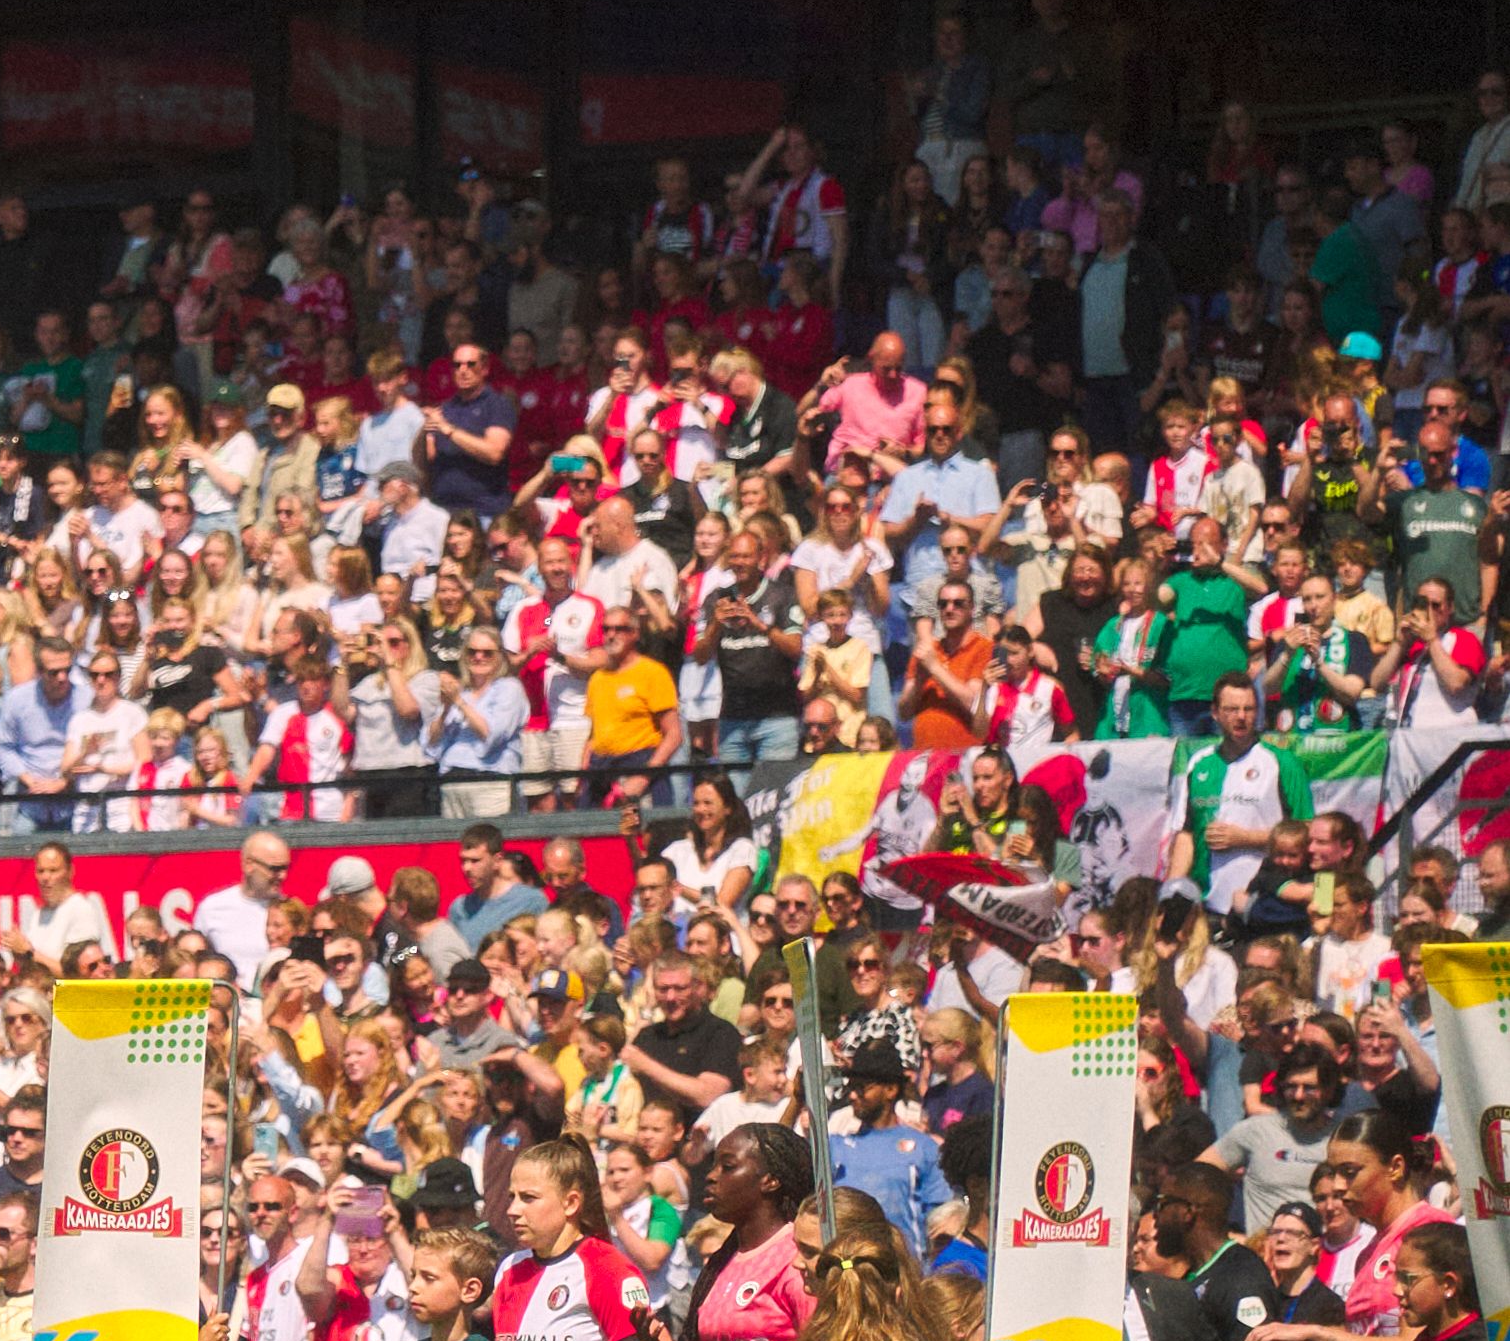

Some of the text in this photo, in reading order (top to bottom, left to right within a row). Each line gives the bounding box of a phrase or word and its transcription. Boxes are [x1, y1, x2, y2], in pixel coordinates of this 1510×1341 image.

[85, 1129, 155, 1160] FEYENOORD
[84, 1181, 156, 1212] ROTTERDAM
[66, 1202, 170, 1230] KAMERAADJES
[1024, 1213, 1101, 1241] KAMERAADJES
